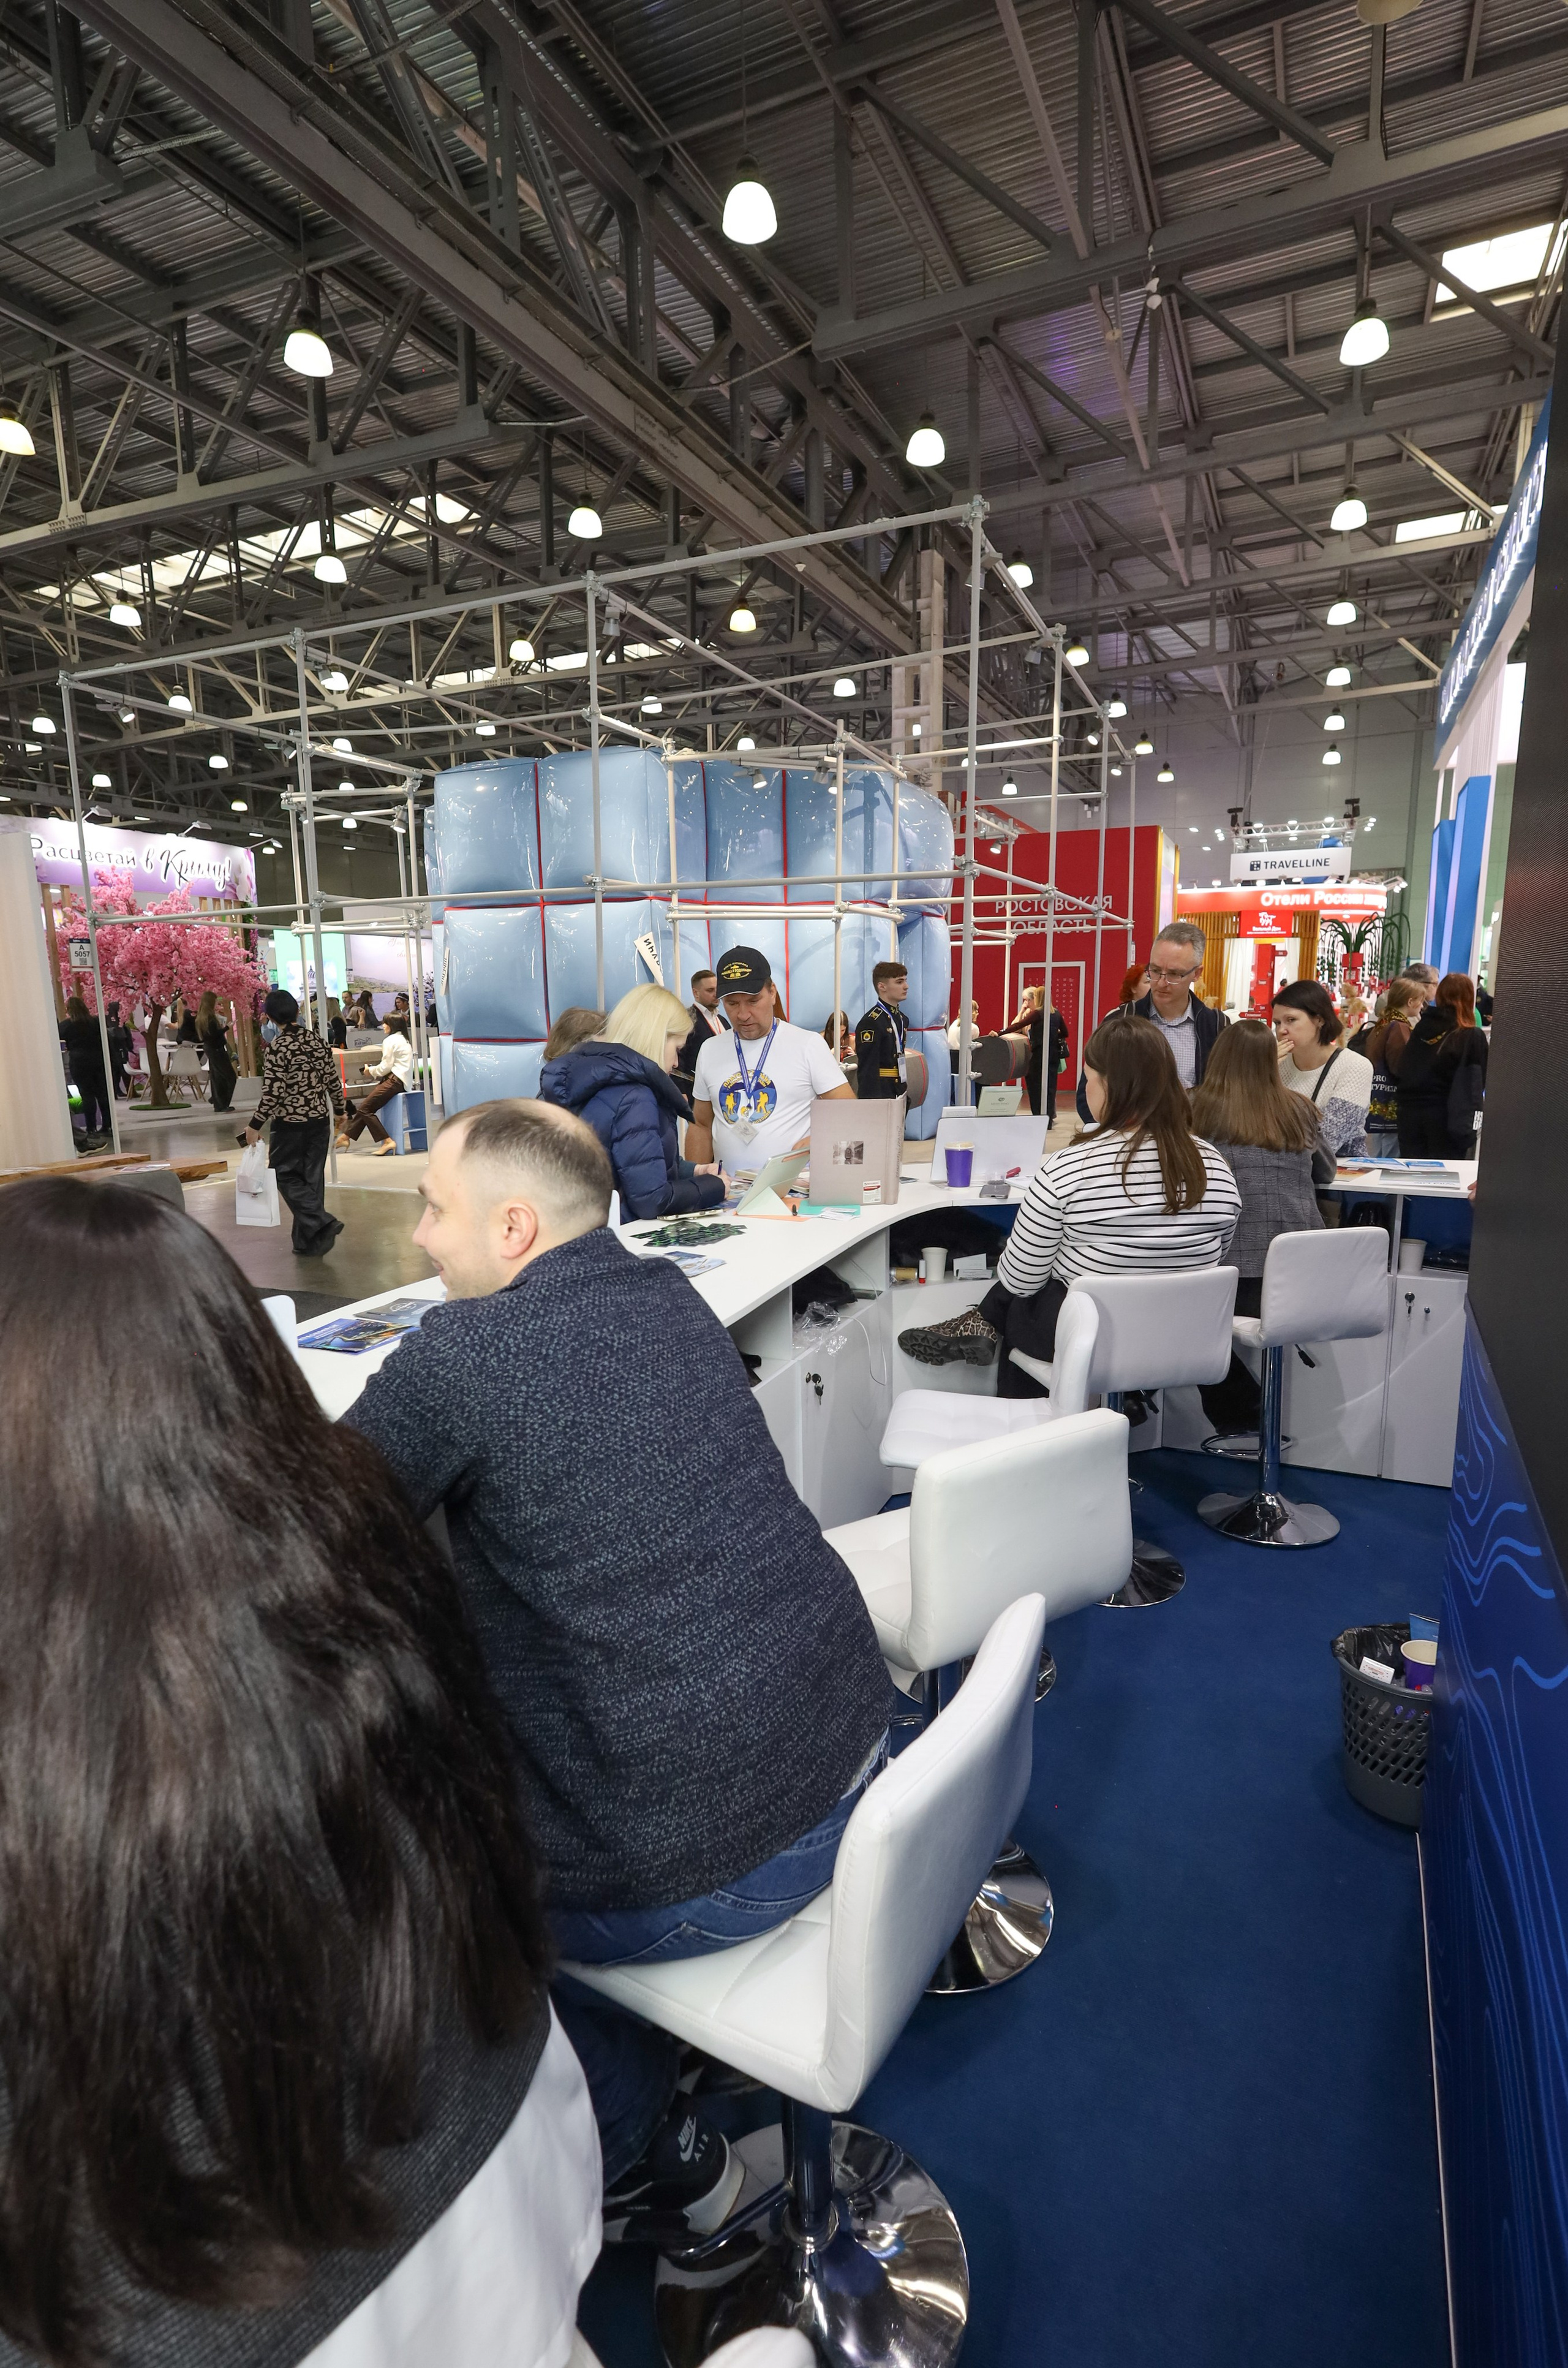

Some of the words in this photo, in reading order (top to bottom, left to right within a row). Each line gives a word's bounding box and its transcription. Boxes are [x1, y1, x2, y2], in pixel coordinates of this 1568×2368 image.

[1264, 858, 1330, 869] TRAVELLINE
[1261, 892, 1311, 906] Отели
[1313, 891, 1364, 905] России
[677, 2115, 693, 2149] NIKE
[693, 2133, 709, 2162] AIR
